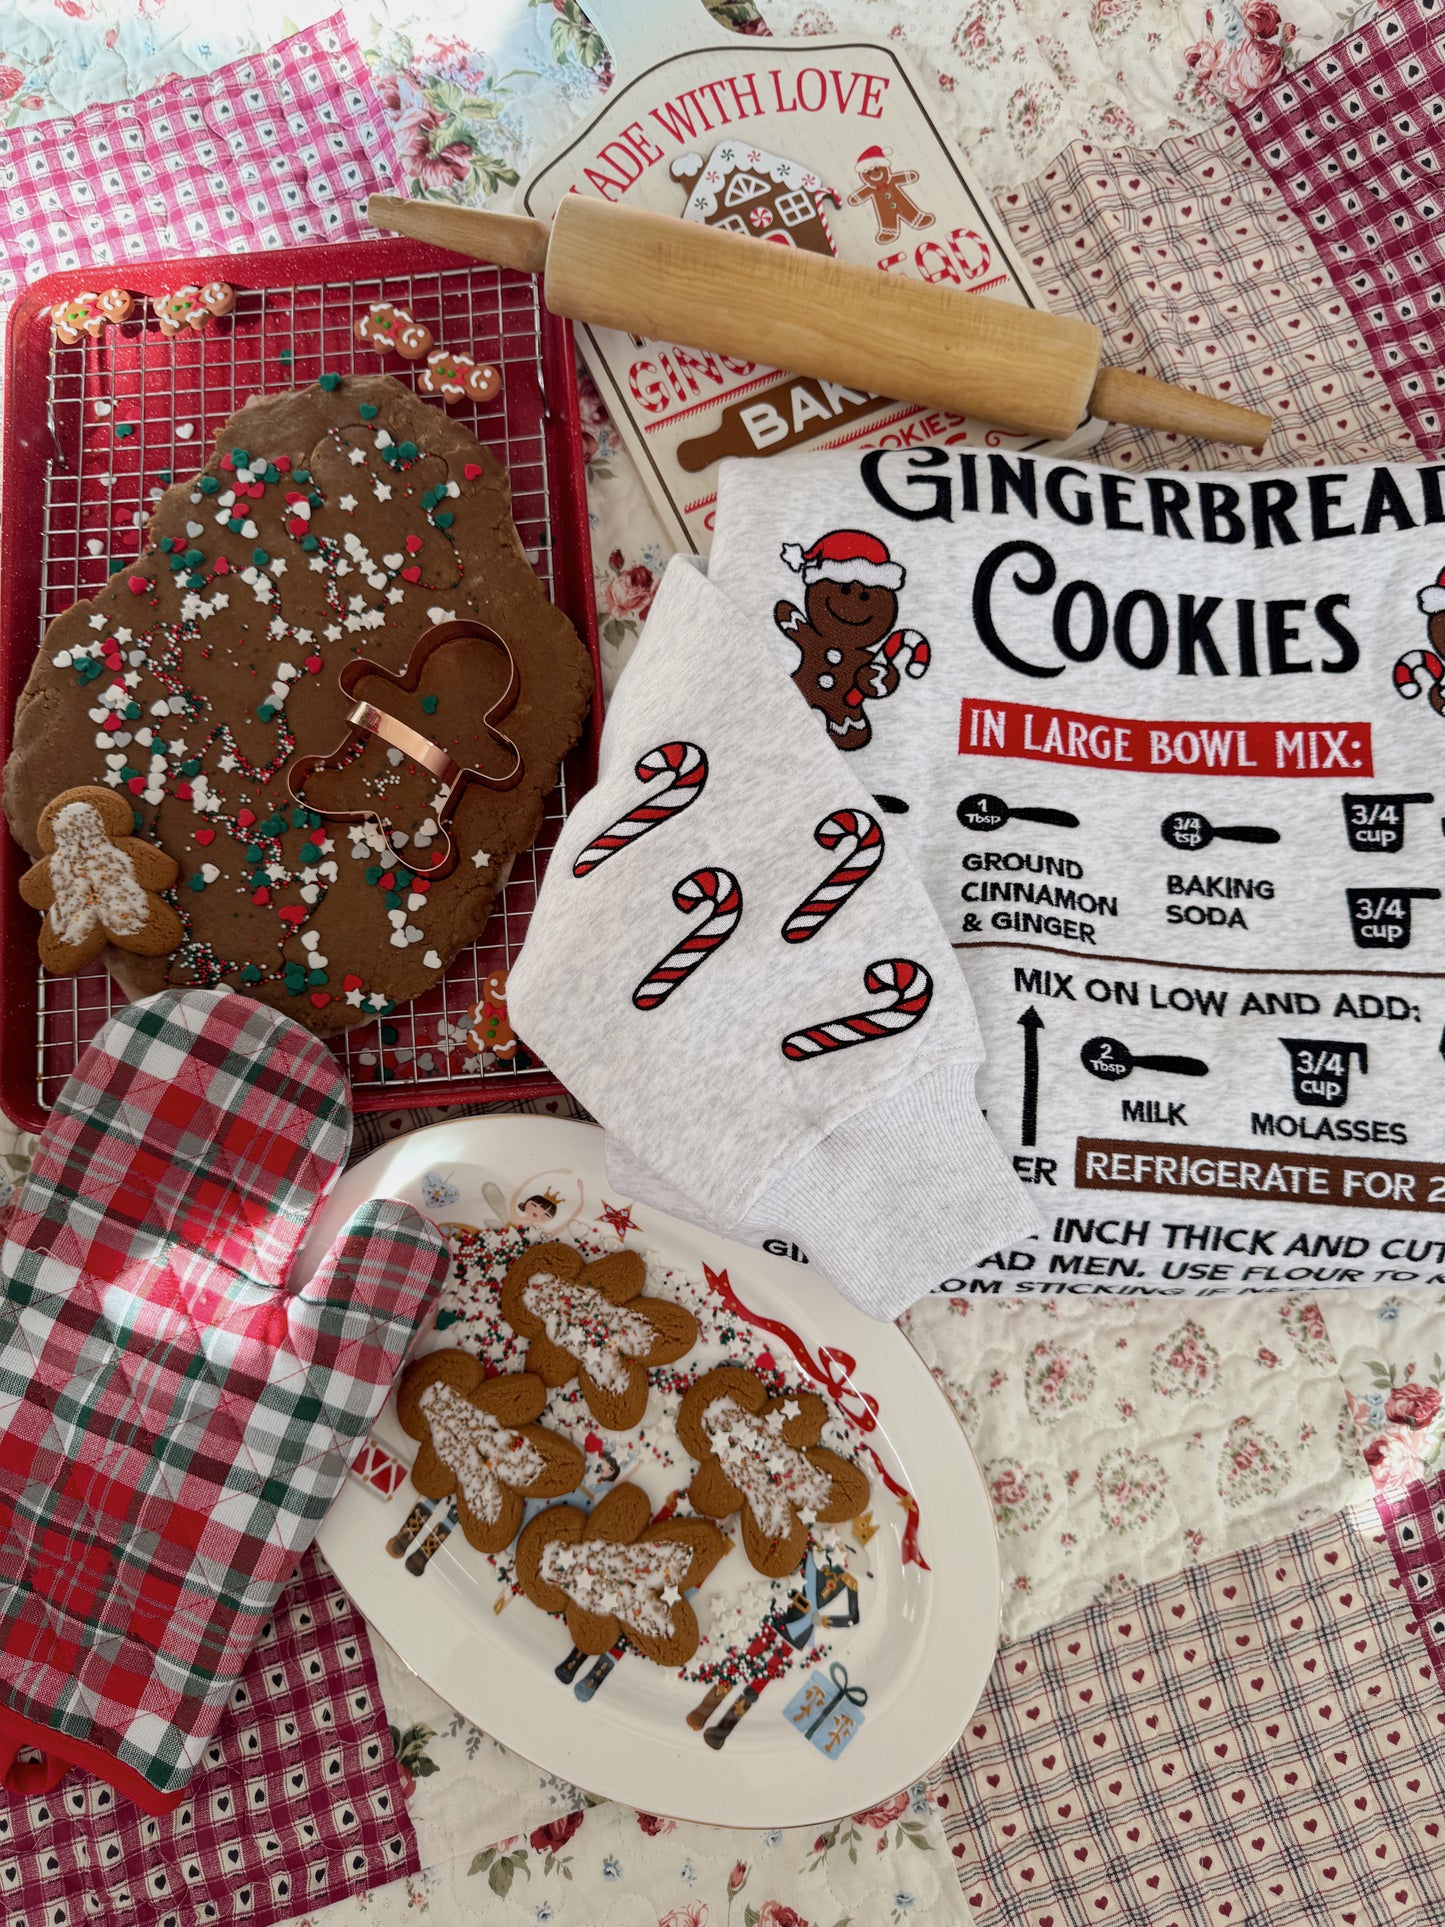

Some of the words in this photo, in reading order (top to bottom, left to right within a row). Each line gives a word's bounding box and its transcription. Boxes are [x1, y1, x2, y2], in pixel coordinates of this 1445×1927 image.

[551, 121, 665, 220] ADE
[648, 73, 765, 145] WITH
[768, 68, 890, 119] LOVE
[739, 379, 880, 450] BAK
[860, 446, 1445, 549] GINGERBREAD
[972, 540, 1360, 678] COOKIES
[969, 708, 1006, 748] IN
[1023, 713, 1133, 762] LARGE
[1149, 729, 1258, 767] BOWL
[1275, 730, 1363, 769] MIX:
[964, 813, 1001, 825] Tbsp
[976, 799, 988, 813] 1
[1351, 804, 1400, 825] 3/4
[1173, 817, 1201, 831] 3/4
[1173, 831, 1202, 846] tsp
[1355, 830, 1397, 847] cup
[962, 852, 1084, 879] GROUND
[961, 881, 1119, 917] CINNAMON
[1166, 874, 1275, 900] BAKING
[1166, 905, 1248, 930] SODA
[1355, 897, 1406, 920] 3/4
[962, 912, 983, 932] &
[991, 911, 1097, 945] GINGER
[1360, 924, 1404, 943] cup
[1014, 967, 1077, 1001] MIX
[1085, 978, 1139, 1006] ON
[1150, 984, 1228, 1017] LOW
[1240, 992, 1320, 1016] AND
[1333, 993, 1421, 1022] ADD:
[1100, 1043, 1114, 1060] 2
[1297, 1050, 1344, 1077] 3/4
[1090, 1059, 1127, 1074] Tbsp
[1300, 1080, 1342, 1101] cup
[1122, 1099, 1189, 1127] MILK
[1251, 1112, 1408, 1145] MOLASSES
[1086, 1151, 1331, 1195] REFRIGERATE
[1343, 1168, 1416, 1203] FOR
[1053, 1217, 1151, 1247] INCH
[1162, 1223, 1278, 1256] THICK
[1283, 1233, 1370, 1259] AND
[1049, 1254, 1146, 1278] MEN.
[1161, 1261, 1235, 1281] USE
[1241, 1266, 1364, 1283] FLOUR
[1372, 1270, 1419, 1282] TO
[930, 1278, 1002, 1294] OM
[1014, 1281, 1185, 1297] STICKING
